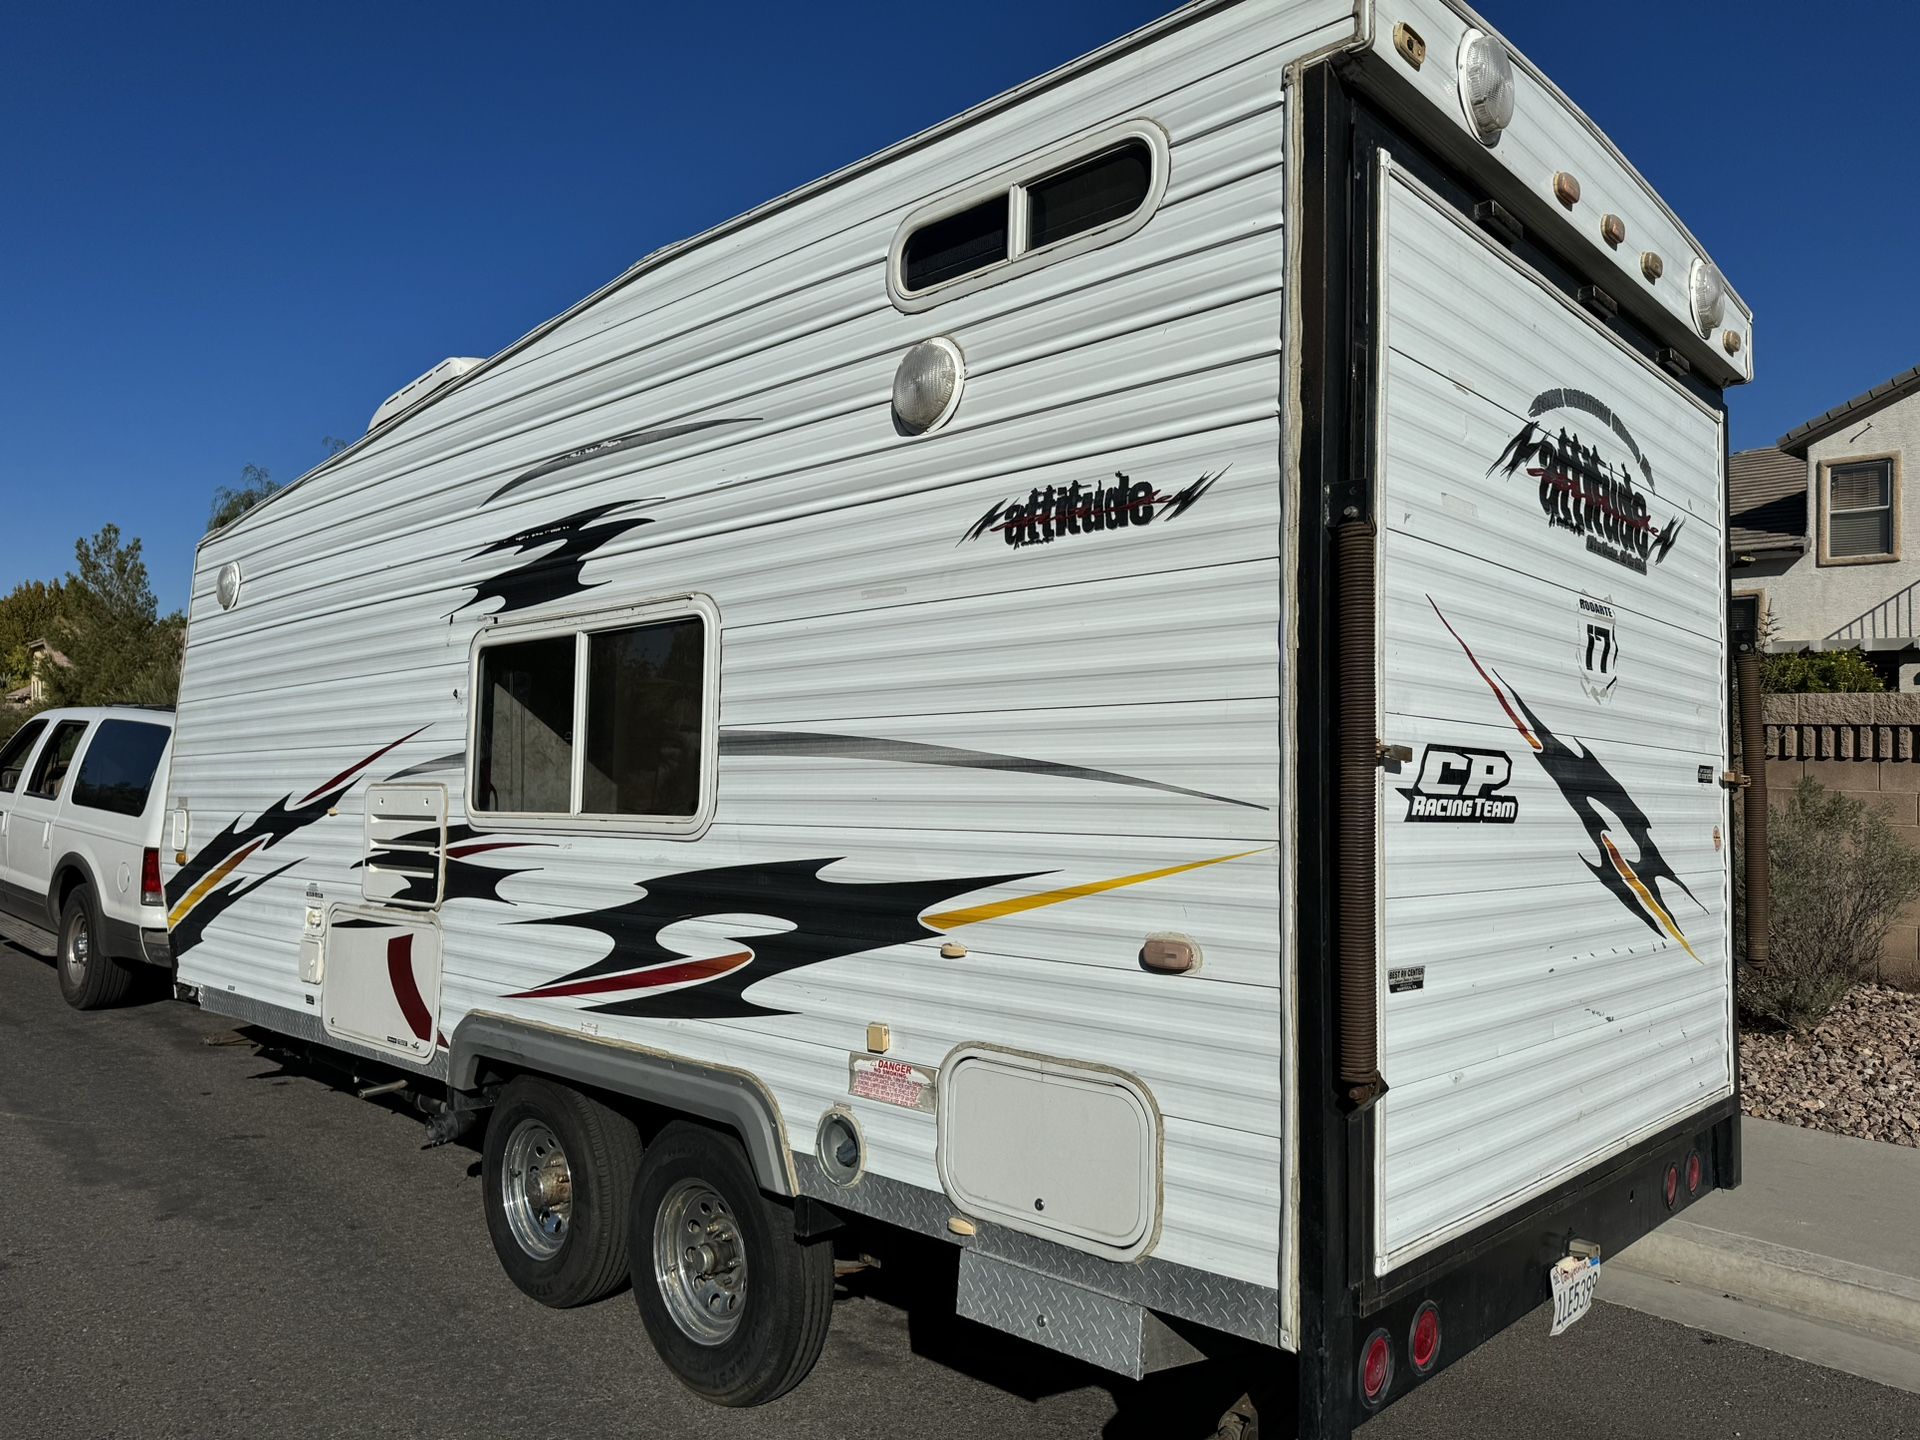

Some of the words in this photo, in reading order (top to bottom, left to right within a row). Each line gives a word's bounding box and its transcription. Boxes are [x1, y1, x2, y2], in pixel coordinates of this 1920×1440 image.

[1004, 471, 1154, 545] attitude
[1579, 598, 1613, 618] RODARTE
[1586, 624, 1610, 673] 17
[1417, 750, 1509, 796] CP
[1411, 795, 1473, 817] RACING
[1475, 798, 1515, 818] TEAM
[1407, 968, 1424, 977] CENTER
[878, 1059, 912, 1075] DANGER
